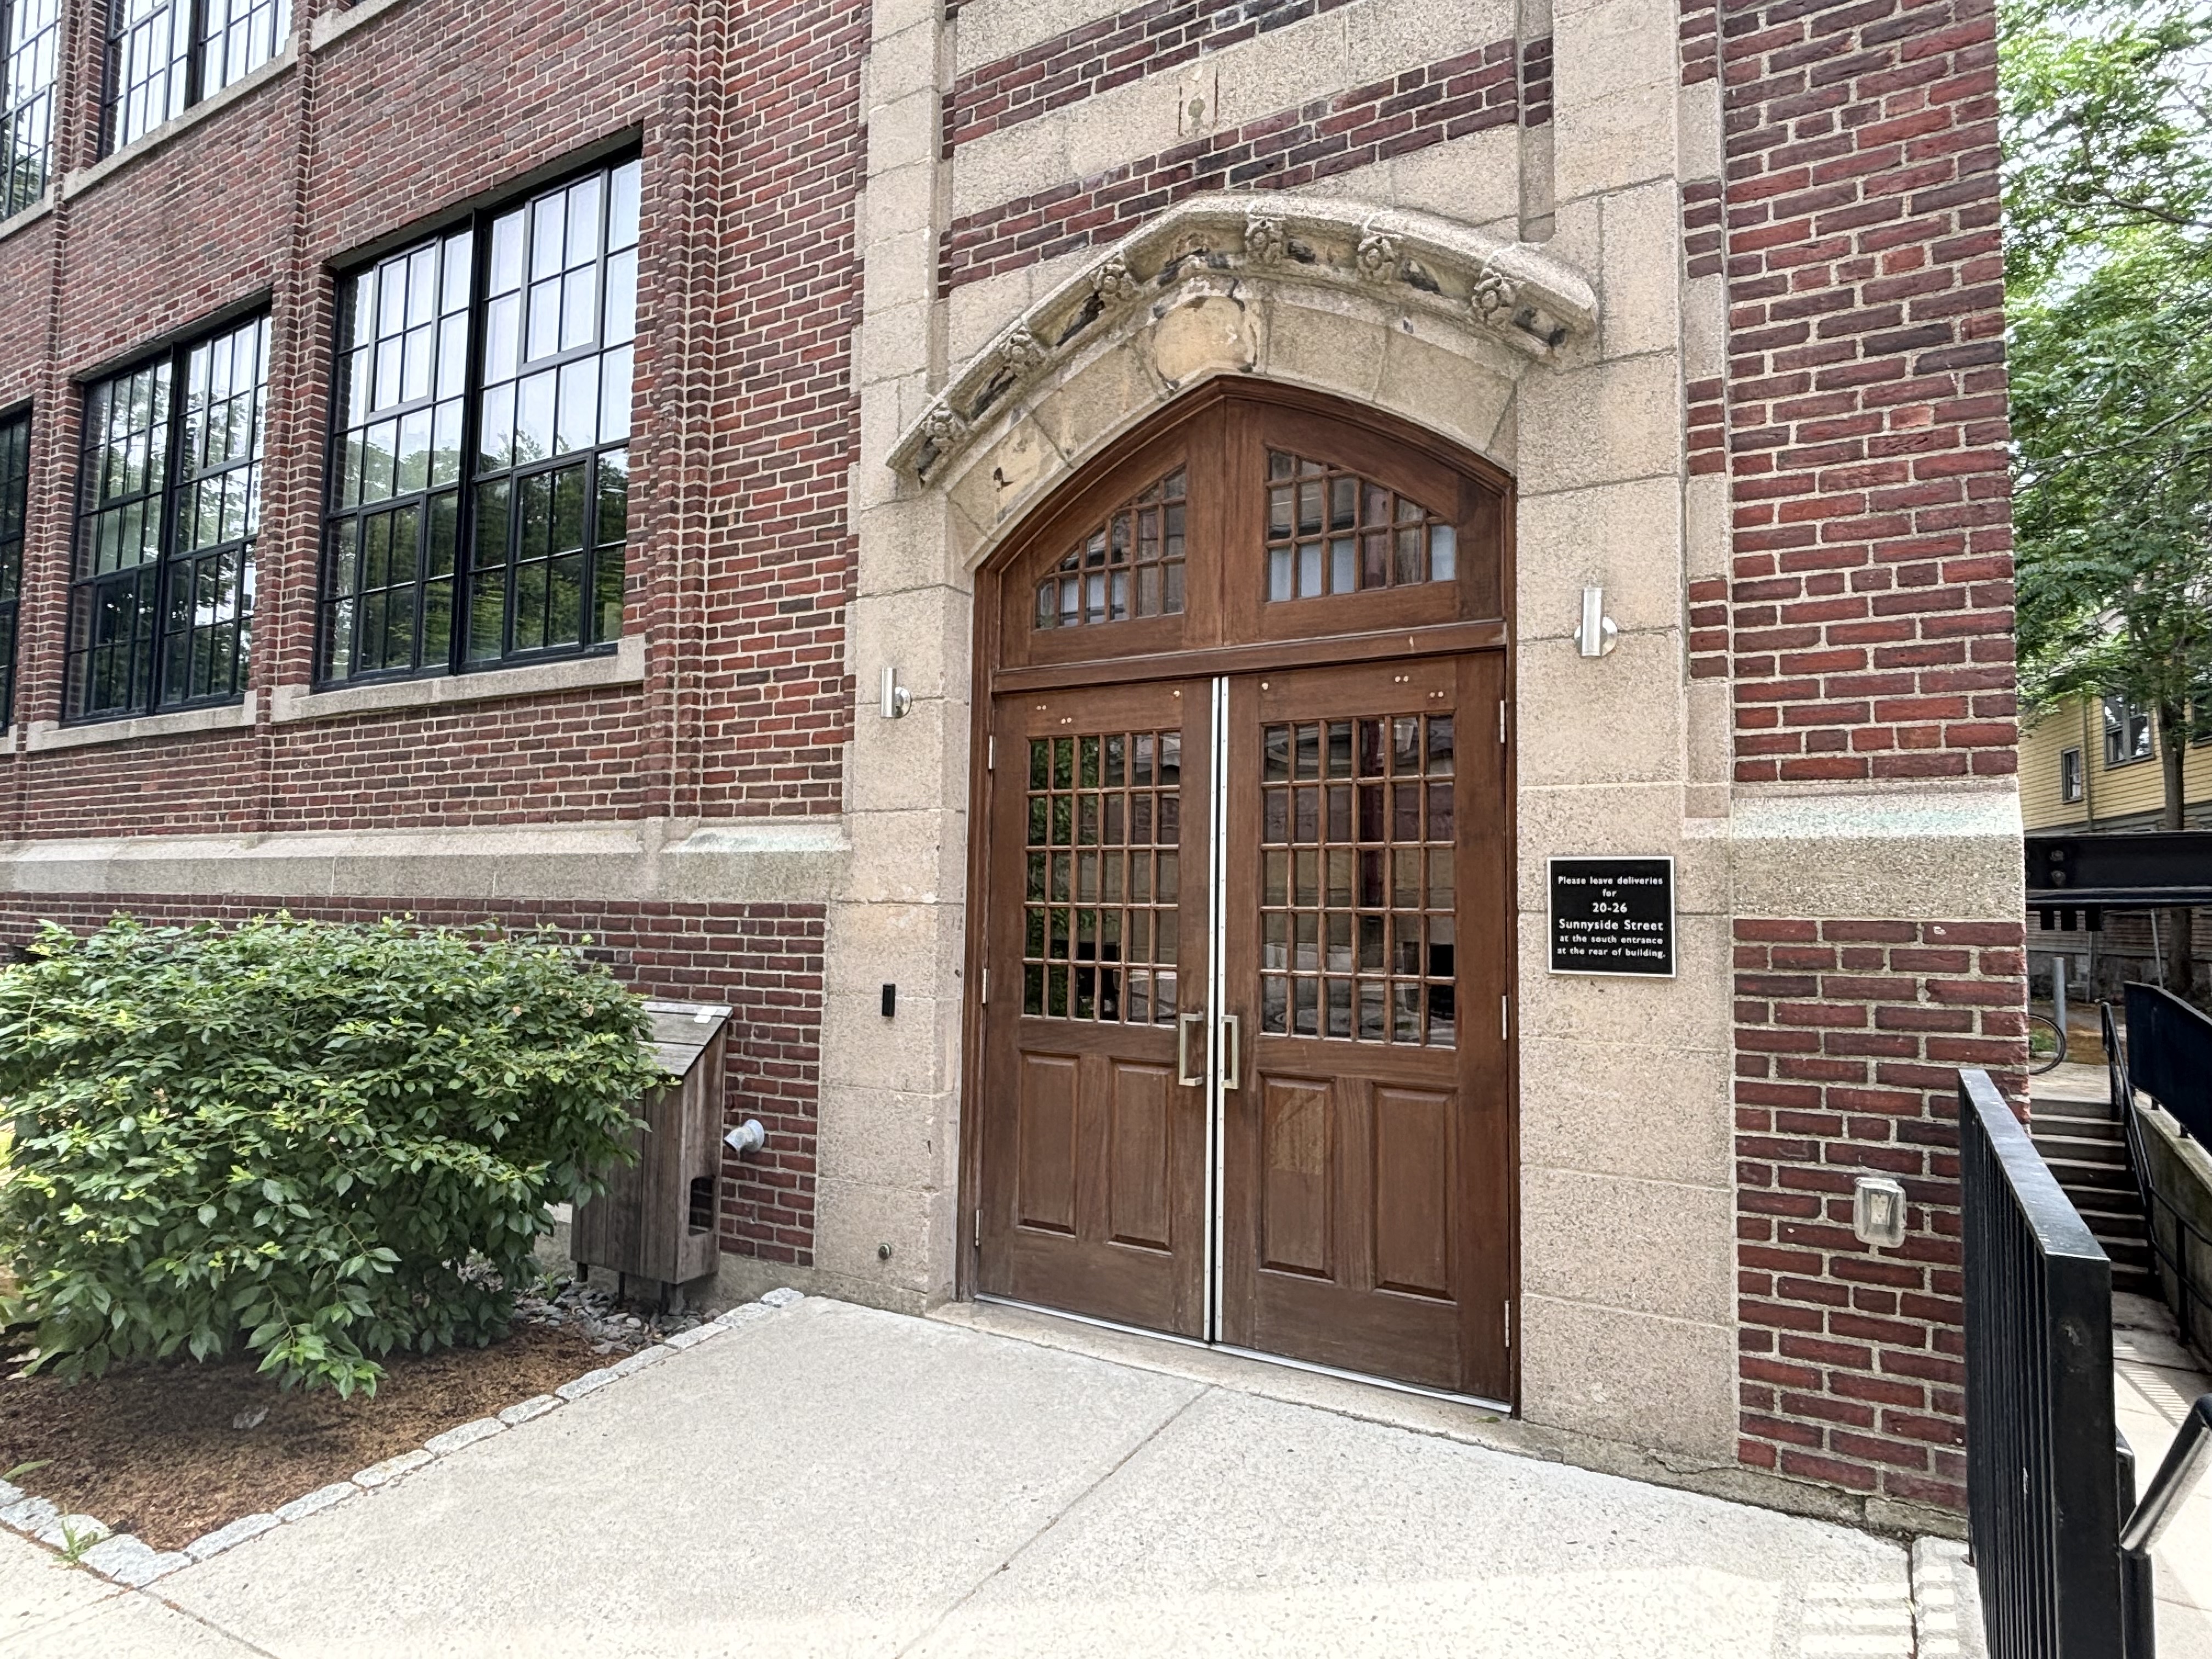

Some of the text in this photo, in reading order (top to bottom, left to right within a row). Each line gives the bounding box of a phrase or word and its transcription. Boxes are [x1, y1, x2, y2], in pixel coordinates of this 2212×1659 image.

[1558, 876, 1663, 885] Please leave deliveries
[1602, 888, 1617, 897] for
[1593, 902, 1628, 913] 20-26
[1559, 918, 1663, 932] Sunnyside Street
[1572, 934, 1587, 943] the
[1591, 935, 1617, 944] south
[1621, 936, 1663, 945] entrance
[1625, 949, 1666, 959] building.
